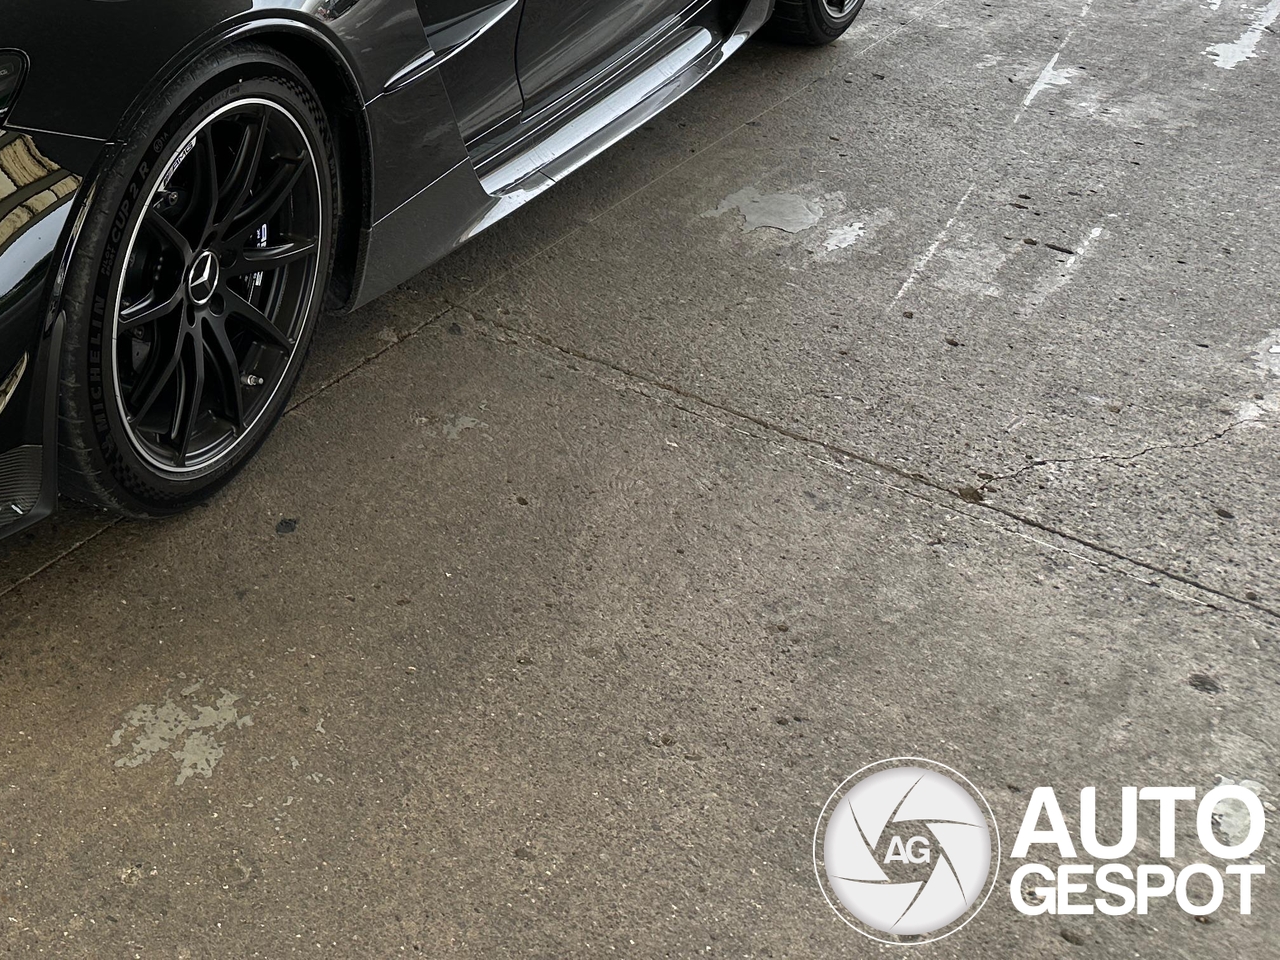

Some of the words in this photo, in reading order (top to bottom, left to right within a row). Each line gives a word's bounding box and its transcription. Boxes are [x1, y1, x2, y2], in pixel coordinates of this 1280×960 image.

[110, 200, 131, 244] CUP
[129, 181, 140, 200] 2
[138, 160, 150, 179] R
[90, 294, 106, 434] MICHELIN
